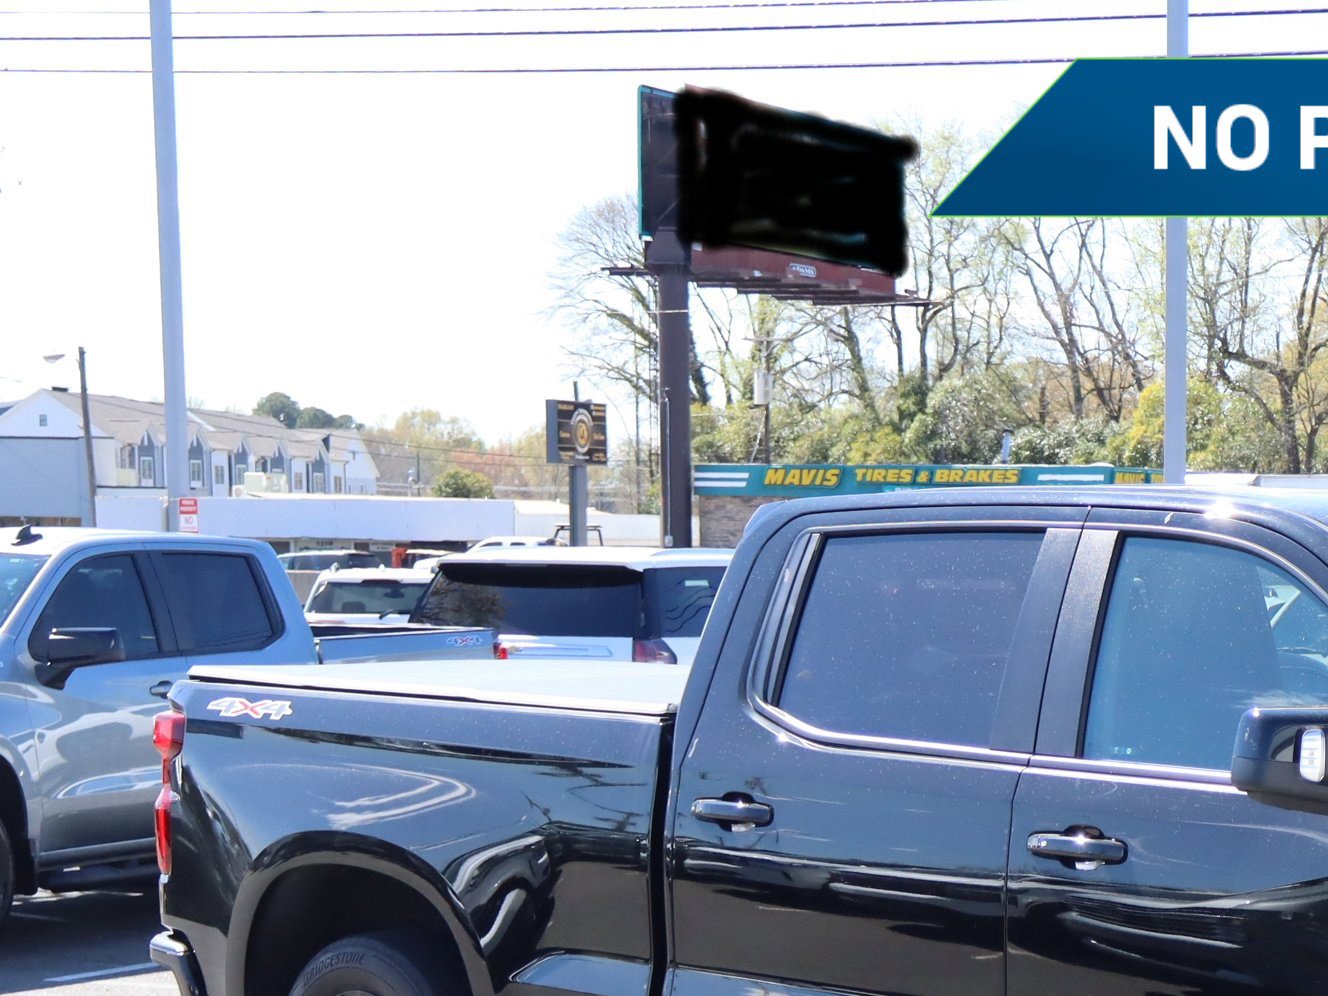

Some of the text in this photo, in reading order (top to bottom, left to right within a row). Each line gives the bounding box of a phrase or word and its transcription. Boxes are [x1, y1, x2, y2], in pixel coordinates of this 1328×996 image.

[763, 467, 841, 487] MAVIS
[855, 468, 1020, 484] TIRES & BRAKES
